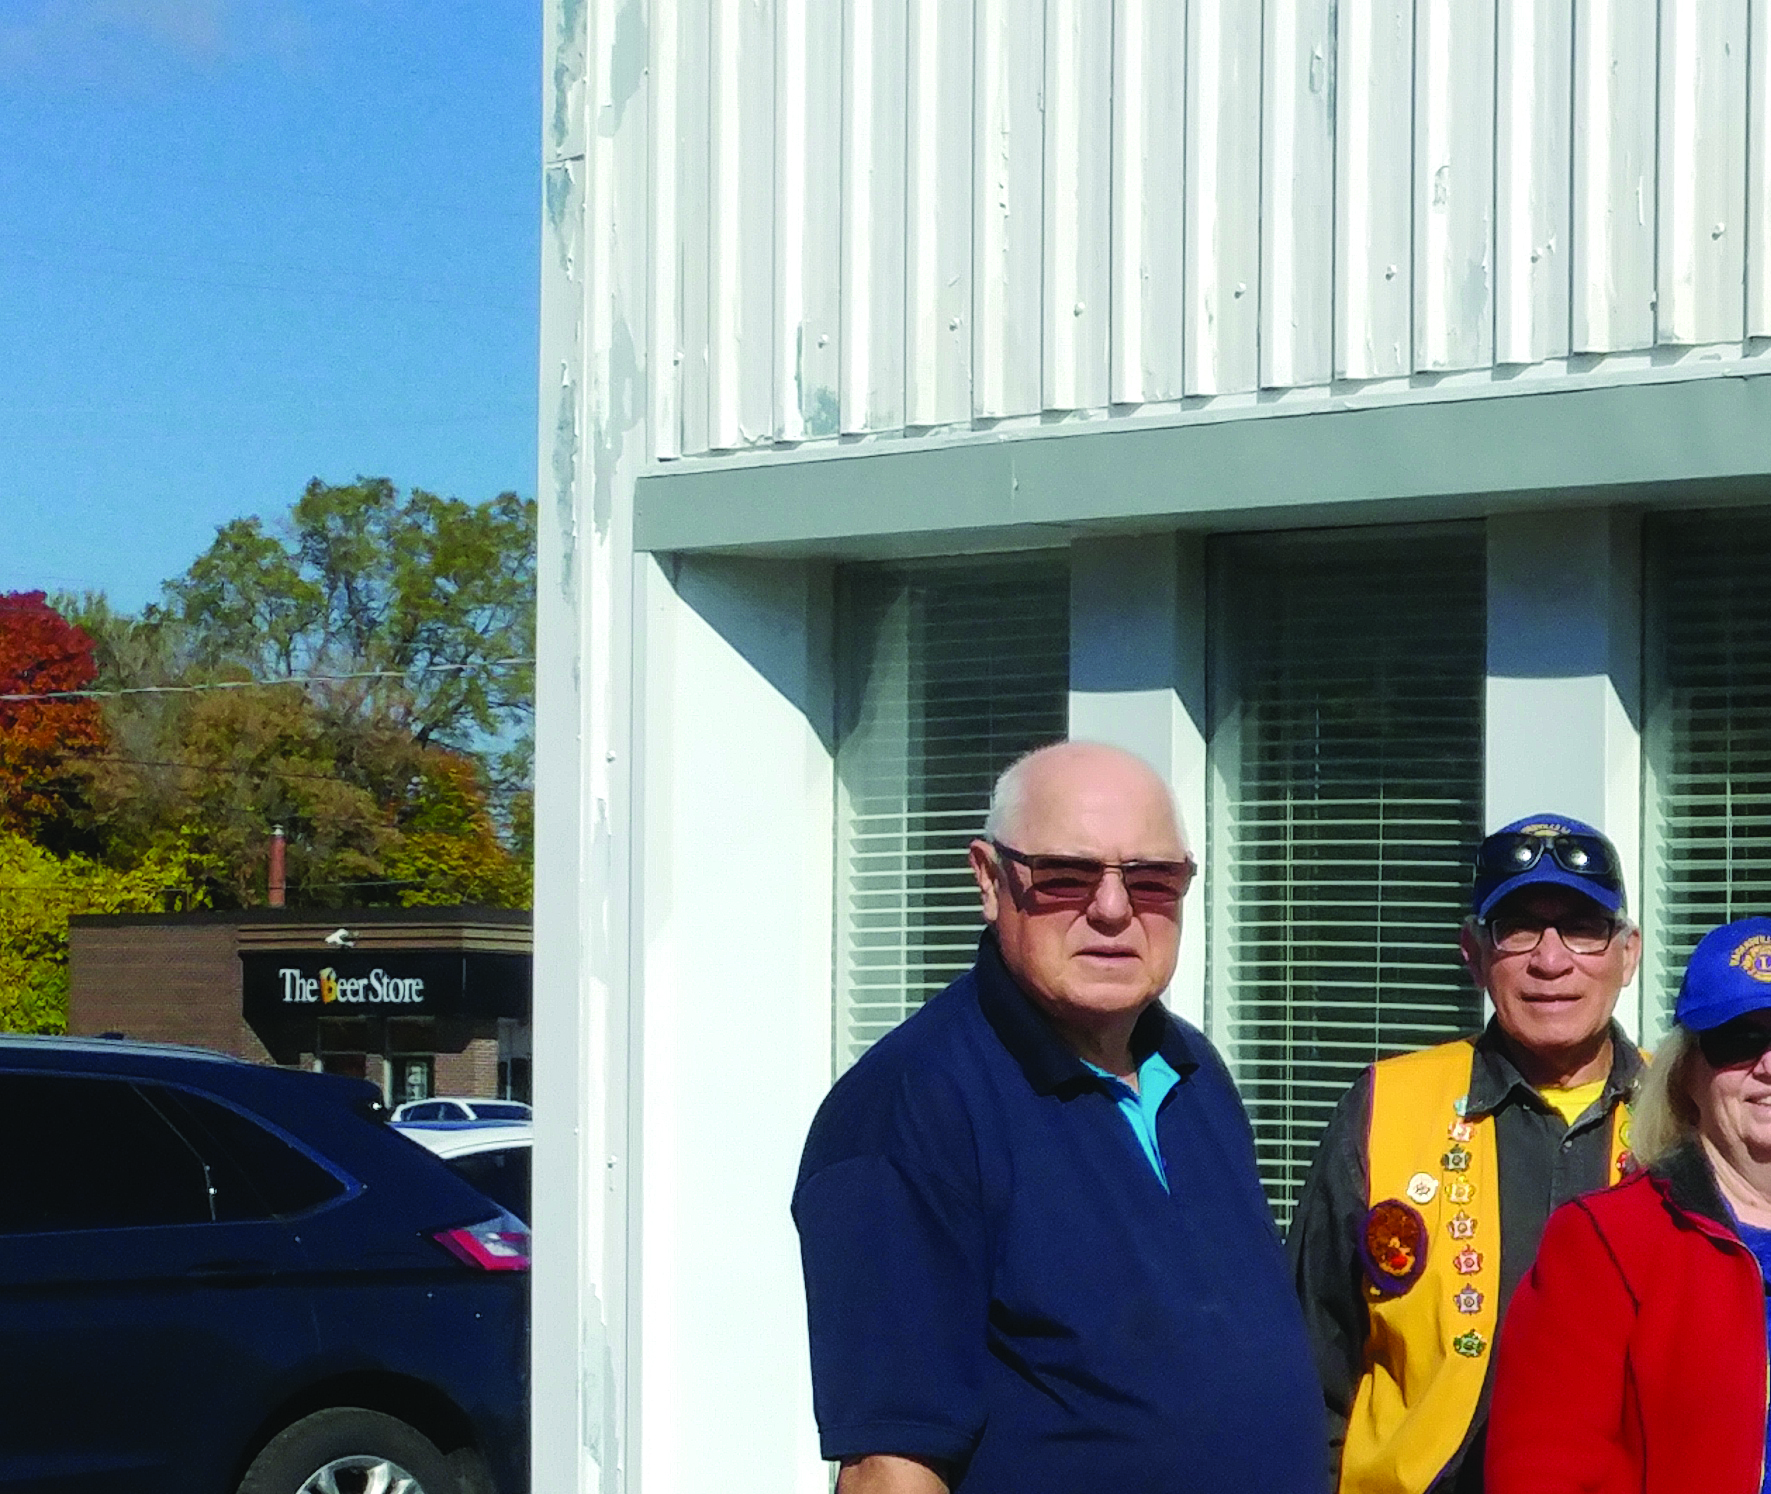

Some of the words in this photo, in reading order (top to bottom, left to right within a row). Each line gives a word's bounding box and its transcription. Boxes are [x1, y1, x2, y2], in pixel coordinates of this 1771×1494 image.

[278, 968, 319, 1003] The
[319, 966, 368, 1004] Beer
[368, 968, 424, 1003] Store
